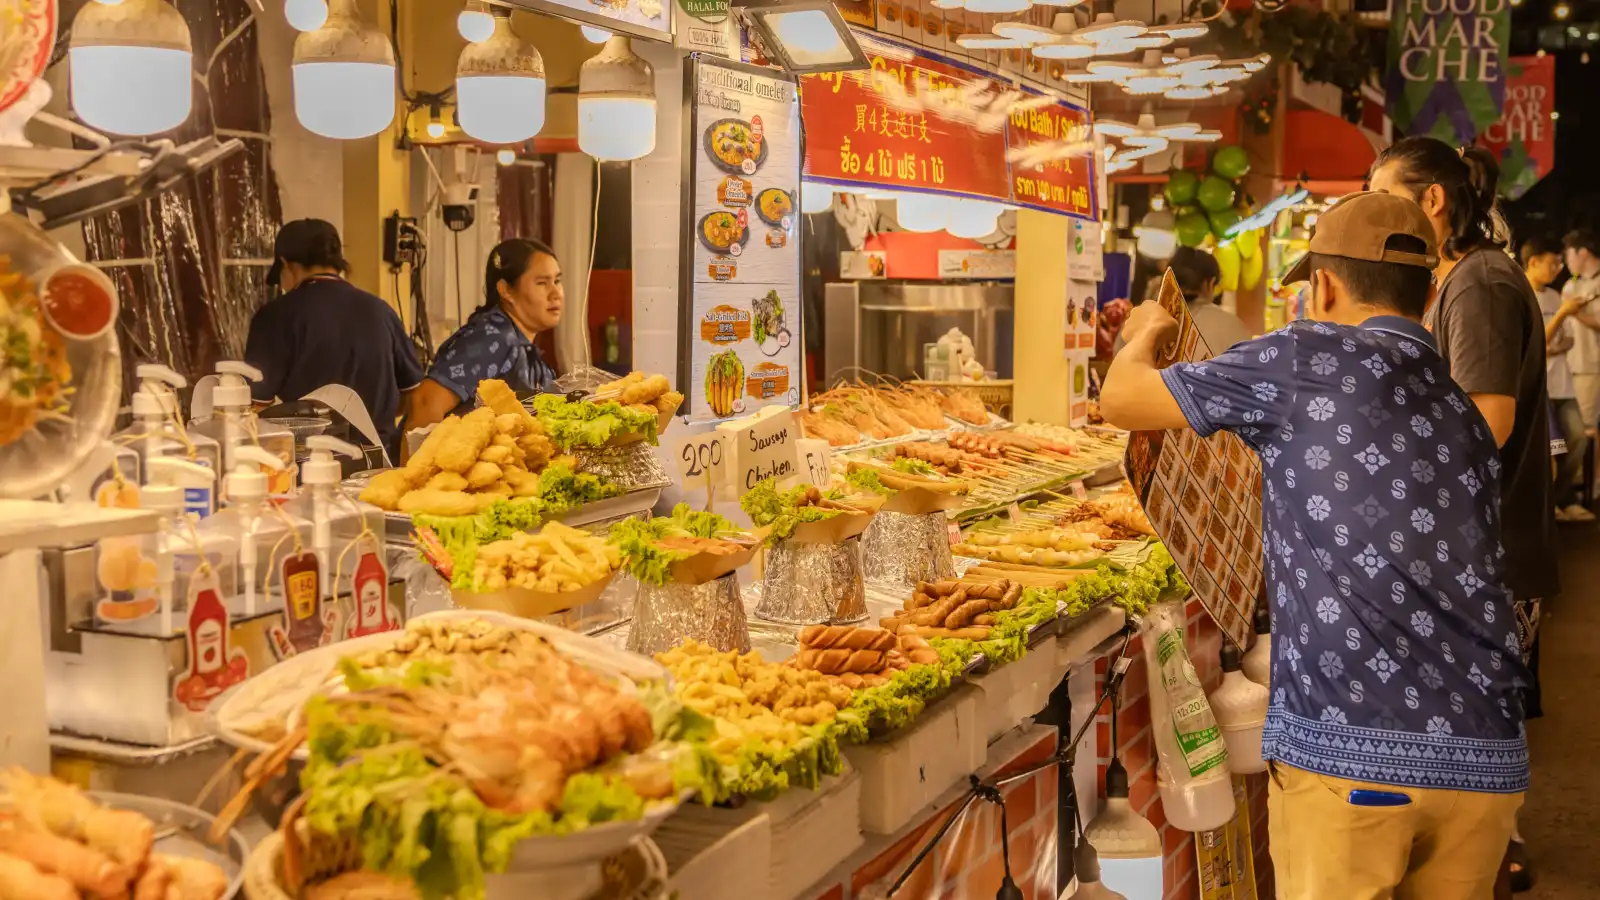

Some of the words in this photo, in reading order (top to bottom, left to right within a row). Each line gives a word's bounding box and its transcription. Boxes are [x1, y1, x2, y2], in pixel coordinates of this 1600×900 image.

[687, 1, 714, 12] HALAL
[1402, 17, 1498, 47] MAR
[1400, 47, 1499, 82] CHE
[756, 79, 785, 101] omelet
[800, 71, 844, 94] uy
[1501, 100, 1543, 120] AR
[1029, 108, 1053, 139] Bath
[1054, 114, 1059, 140] /
[1485, 120, 1544, 142] CHE
[841, 136, 861, 175] ซื้อ
[865, 153, 875, 176] 4
[921, 160, 927, 182] 1
[750, 427, 788, 452] Sausage
[682, 439, 722, 477] 200
